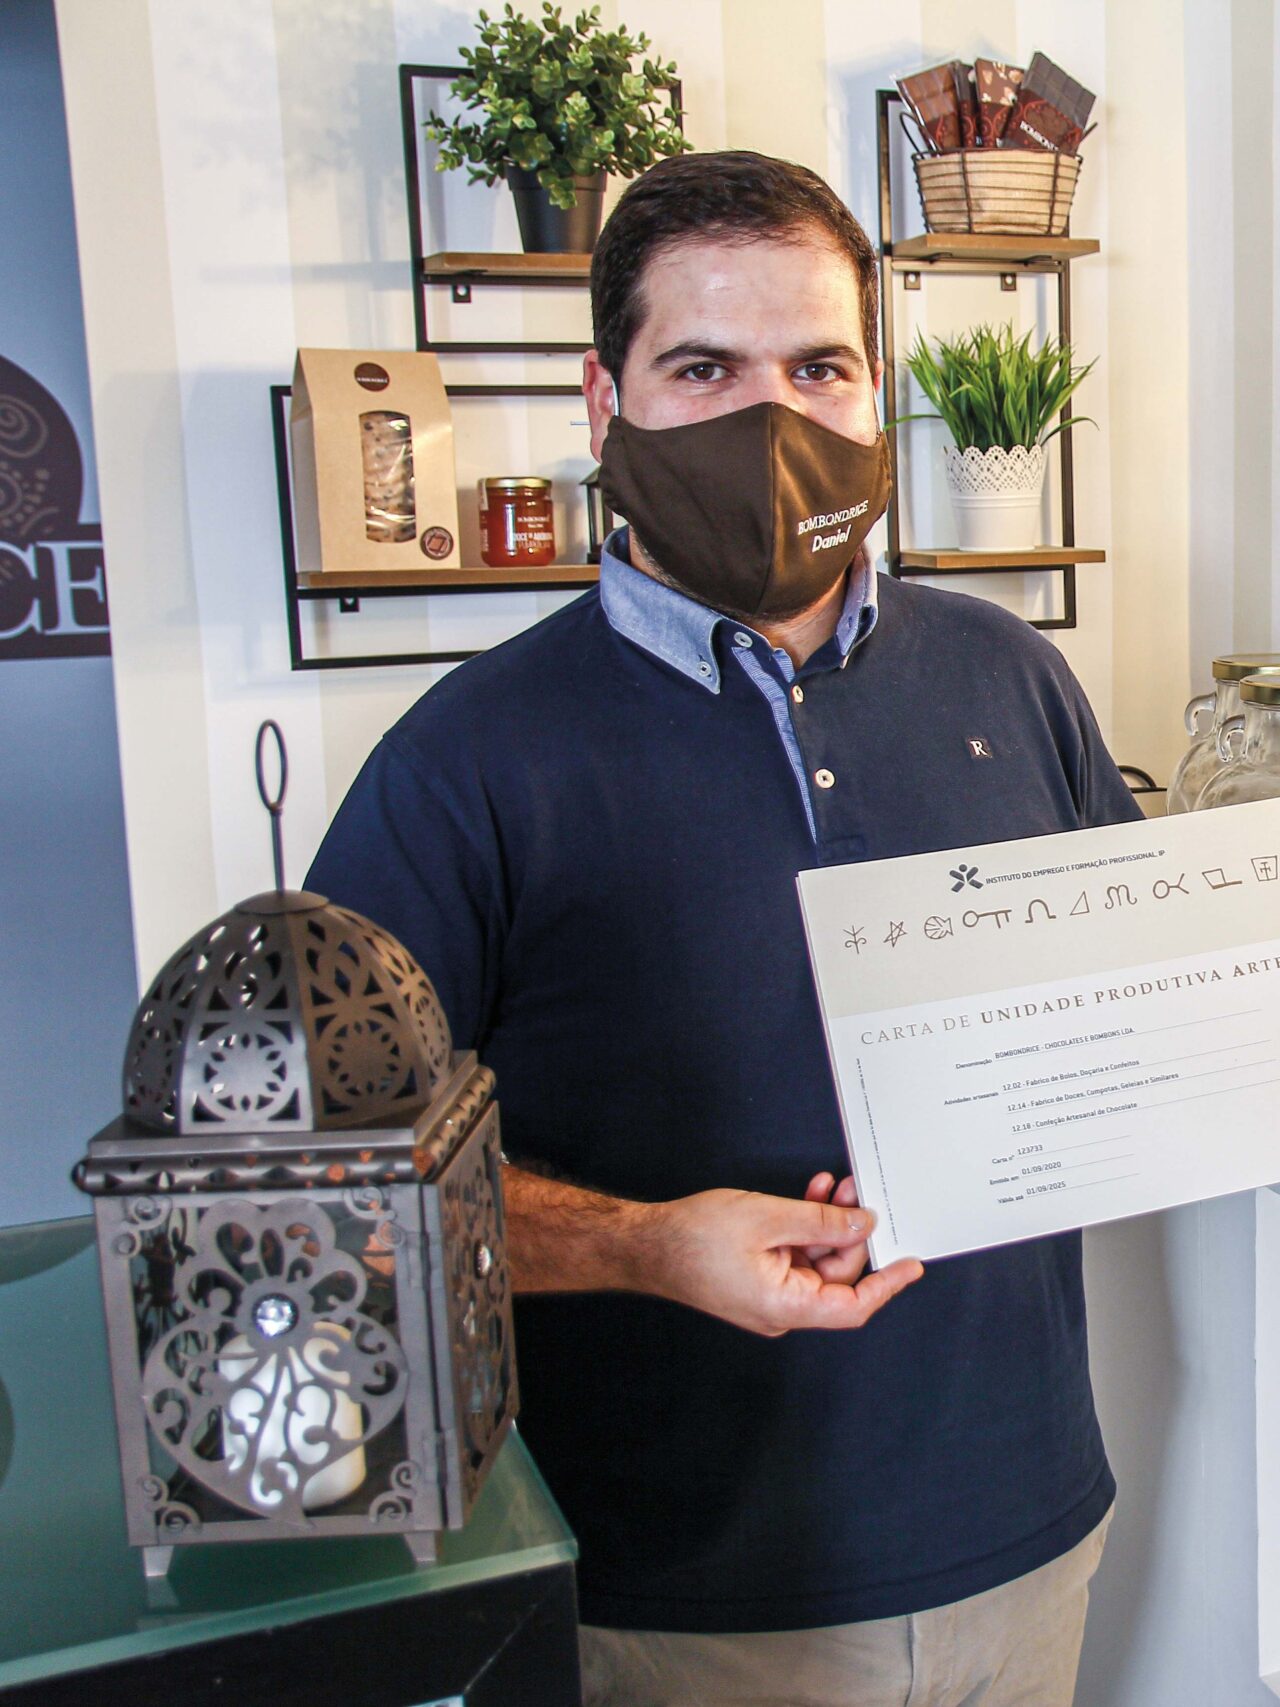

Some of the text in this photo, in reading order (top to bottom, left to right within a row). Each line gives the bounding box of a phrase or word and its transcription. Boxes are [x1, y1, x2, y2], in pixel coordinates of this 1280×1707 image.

[798, 500, 868, 535] BOMBONDRICE
[812, 524, 851, 552] Daniel
[986, 872, 1021, 884] INSTITUTO
[1022, 871, 1032, 879] DO
[1033, 866, 1065, 877] EMPREGO
[1071, 859, 1108, 871] FORMAÇÃO
[861, 1022, 934, 1045] CARTA
[943, 1015, 971, 1031] DE
[980, 994, 1086, 1024] UNIDADE
[1094, 969, 1223, 1004] PRODUTIVA
[995, 1045, 1041, 1059] BOMBONDRICE
[1044, 1036, 1084, 1050] CHOCOLATES
[1090, 1030, 1121, 1041] BOMBONS
[1002, 1081, 1021, 1091] 12.02
[1025, 1076, 1050, 1087] Fabrico
[1080, 1066, 1104, 1077] Doçaria
[1110, 1059, 1140, 1070] Confeitos
[1007, 1101, 1026, 1112] 12.14
[1031, 1096, 1055, 1107] Fabrico
[1120, 1079, 1144, 1090] Geleias
[1150, 1072, 1179, 1083] Similares
[1035, 1116, 1065, 1128] Confeção
[1066, 1110, 1097, 1122] Artesanal
[1106, 1102, 1138, 1114] Chocolate
[1022, 1161, 1062, 1175] 01/09/2020
[1026, 1181, 1067, 1195] 01/09/2025
